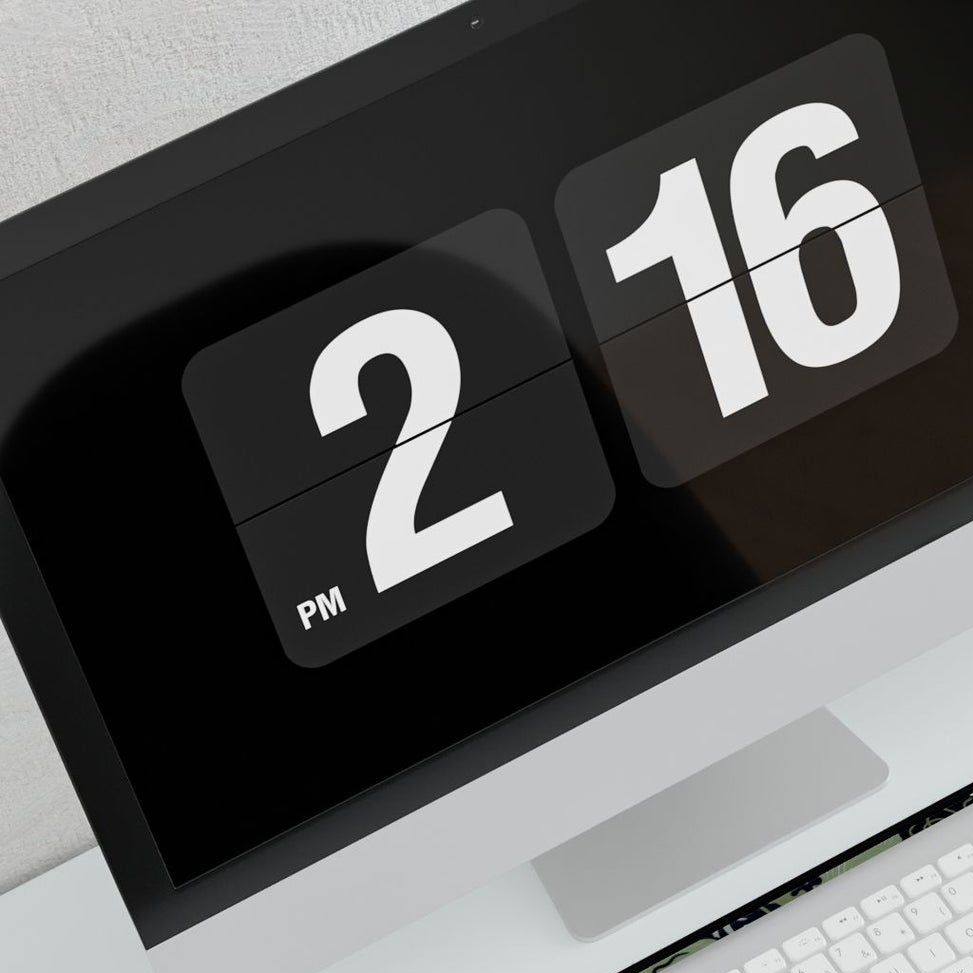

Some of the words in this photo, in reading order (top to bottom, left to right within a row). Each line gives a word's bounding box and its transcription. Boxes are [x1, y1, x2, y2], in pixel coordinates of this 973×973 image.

[606, 103, 900, 417] 16
[310, 309, 513, 593] 2
[297, 586, 346, 630] PM
[947, 886, 958, 896] 0
[910, 907, 919, 917] 9
[872, 927, 883, 937] 8
[834, 946, 842, 958] 7
